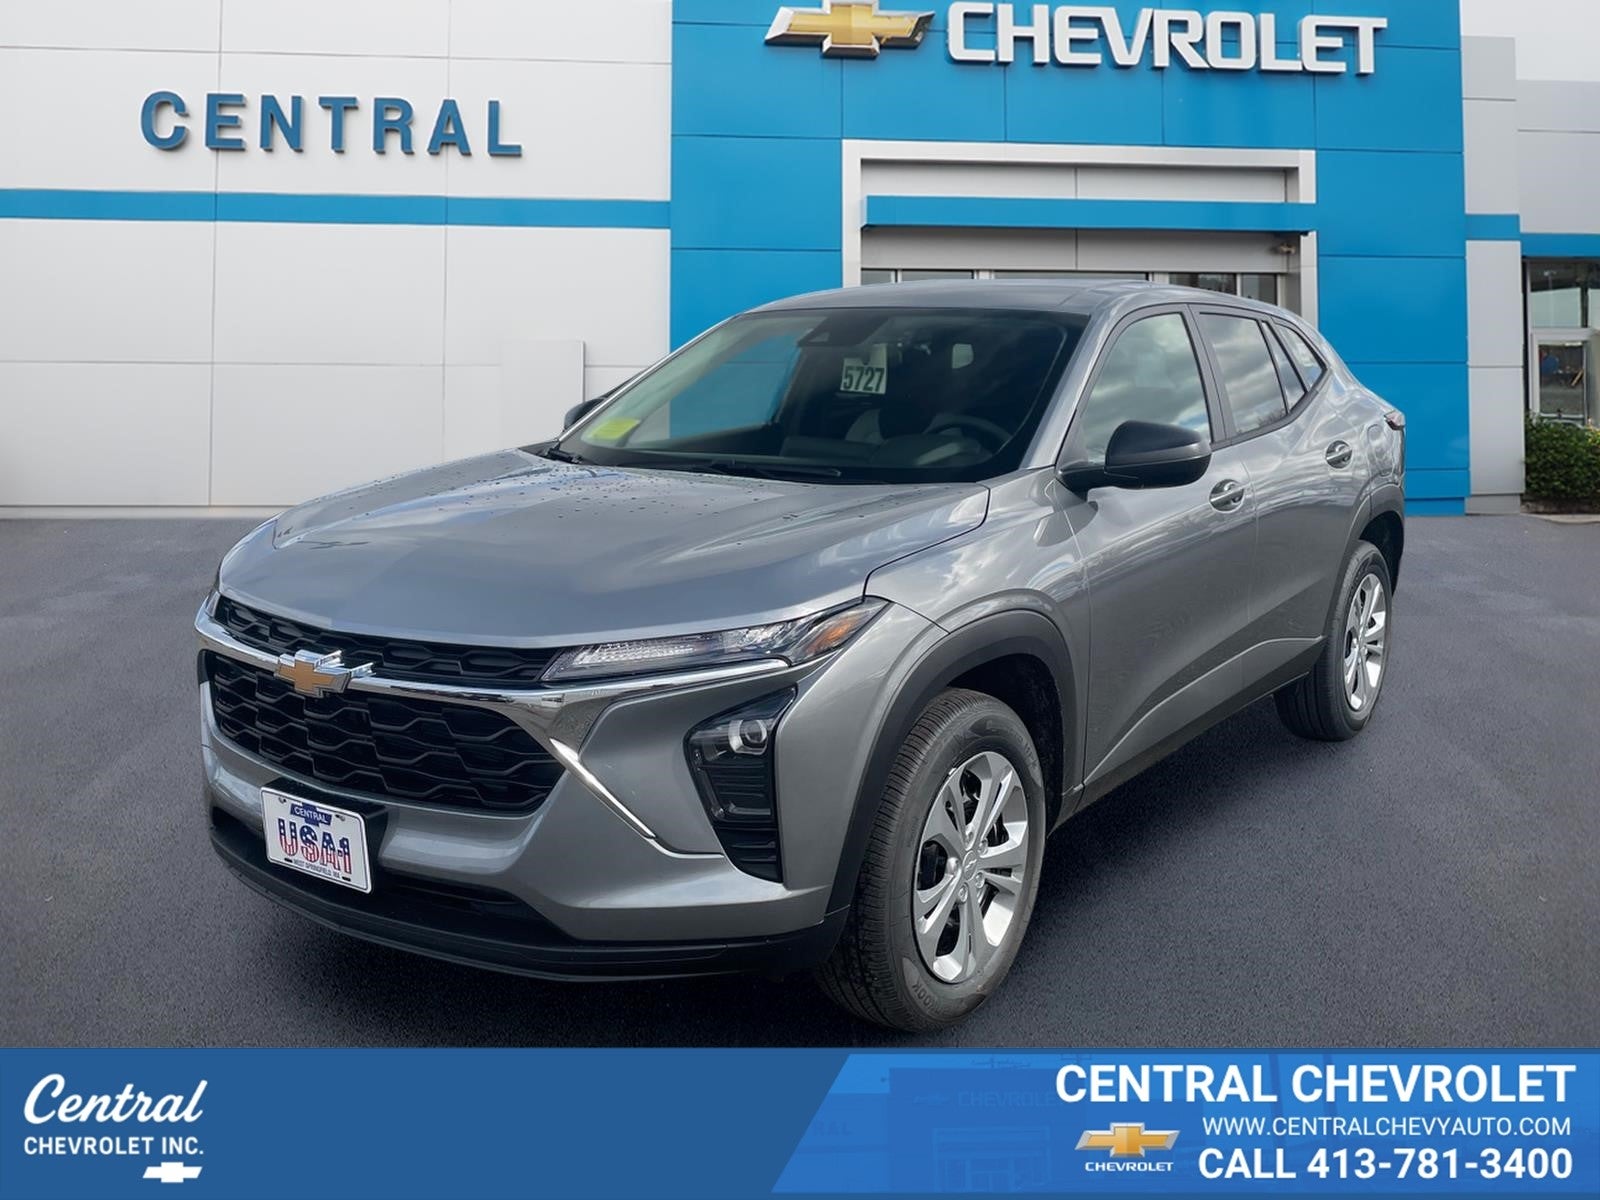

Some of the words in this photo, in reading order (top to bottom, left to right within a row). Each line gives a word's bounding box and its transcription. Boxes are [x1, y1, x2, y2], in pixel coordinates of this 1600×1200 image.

[947, 1, 1388, 74] CHEVROLET
[141, 91, 523, 157] CENTRAL
[843, 366, 885, 392] 5727
[294, 806, 328, 823] CENTRAL
